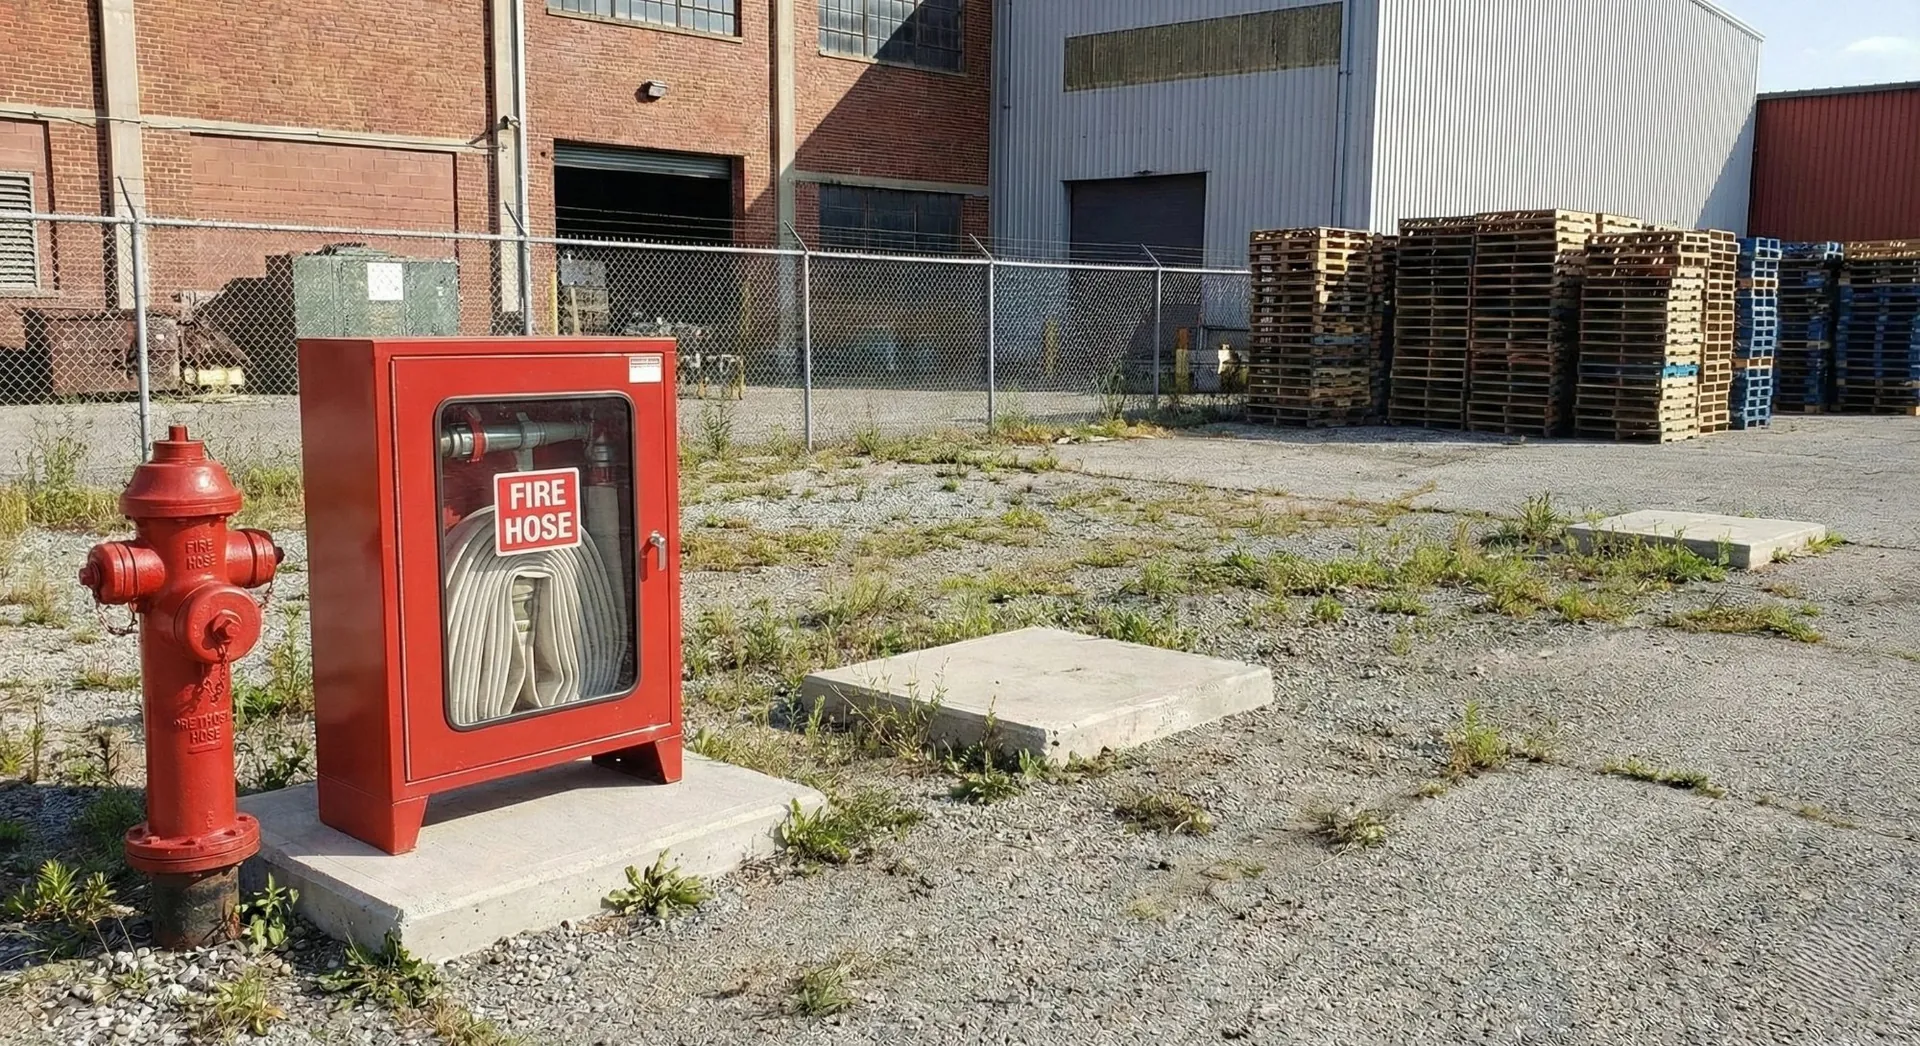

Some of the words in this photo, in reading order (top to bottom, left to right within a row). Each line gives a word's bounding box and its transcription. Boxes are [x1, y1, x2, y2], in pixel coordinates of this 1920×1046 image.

[510, 479, 566, 510] FIRE
[505, 511, 573, 545] HOSE
[185, 538, 213, 554] FIRE
[186, 553, 217, 570] HOSE
[189, 726, 221, 744] HOSE
